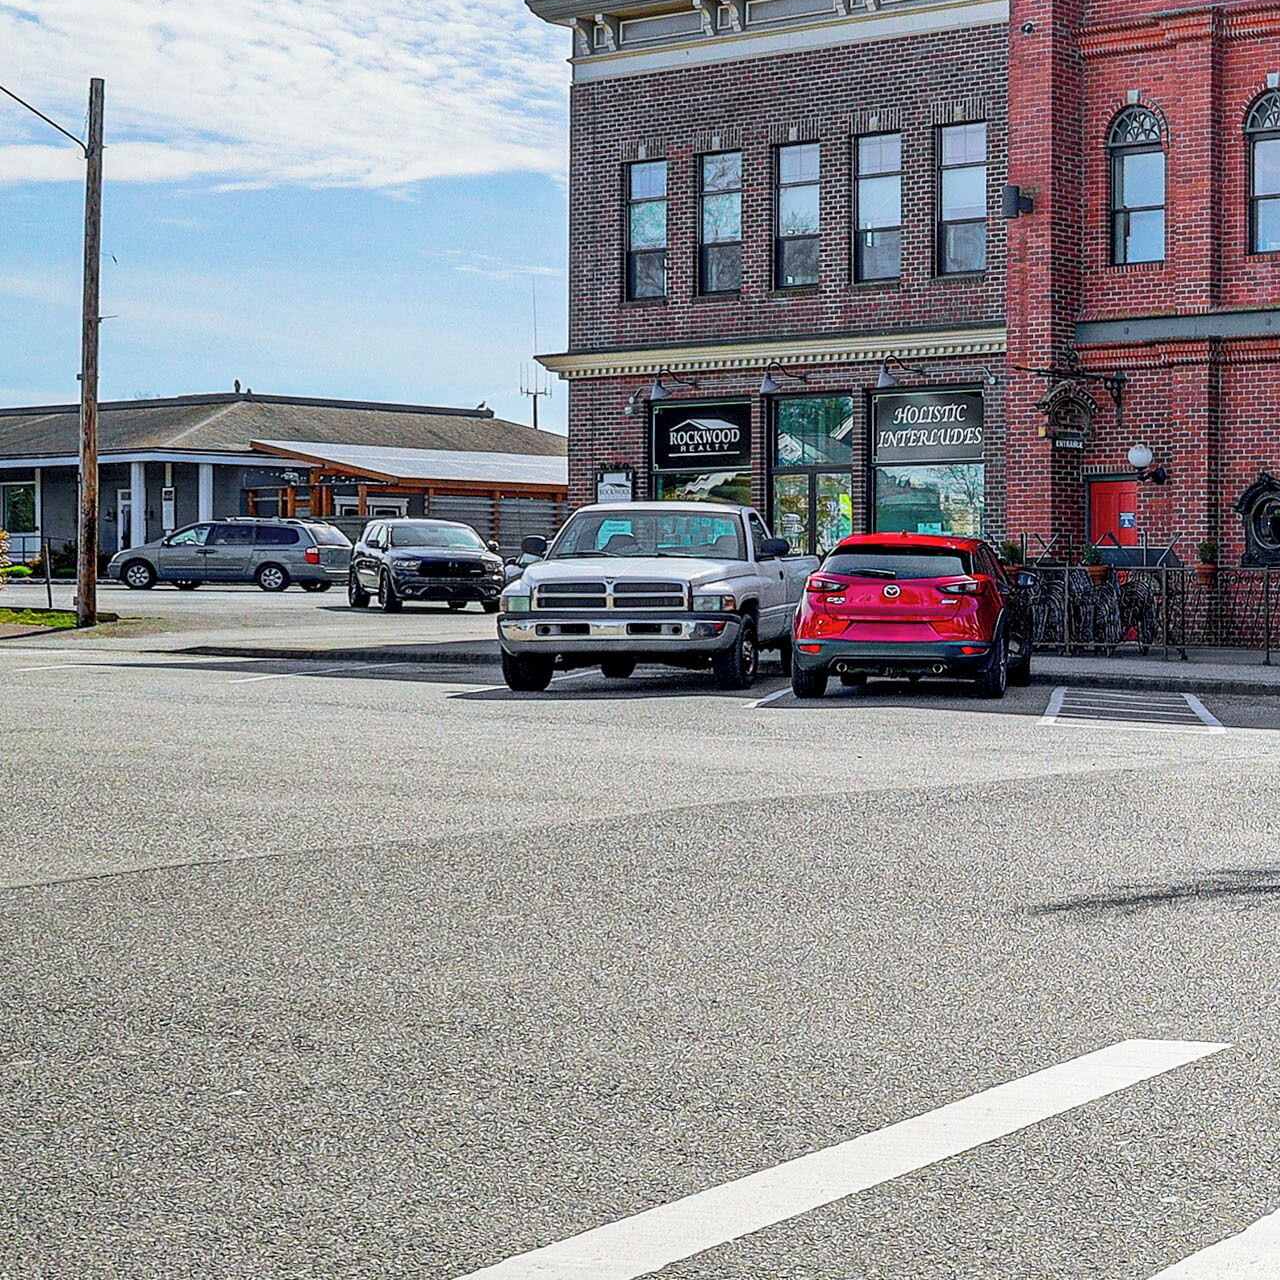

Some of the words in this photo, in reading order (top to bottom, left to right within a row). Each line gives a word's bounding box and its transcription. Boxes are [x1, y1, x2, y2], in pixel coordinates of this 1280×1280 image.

[893, 402, 967, 424] HOLISTIC
[669, 428, 740, 445] ROCKWOOD
[877, 426, 983, 448] INTERLUDES
[680, 443, 730, 452] REALTY
